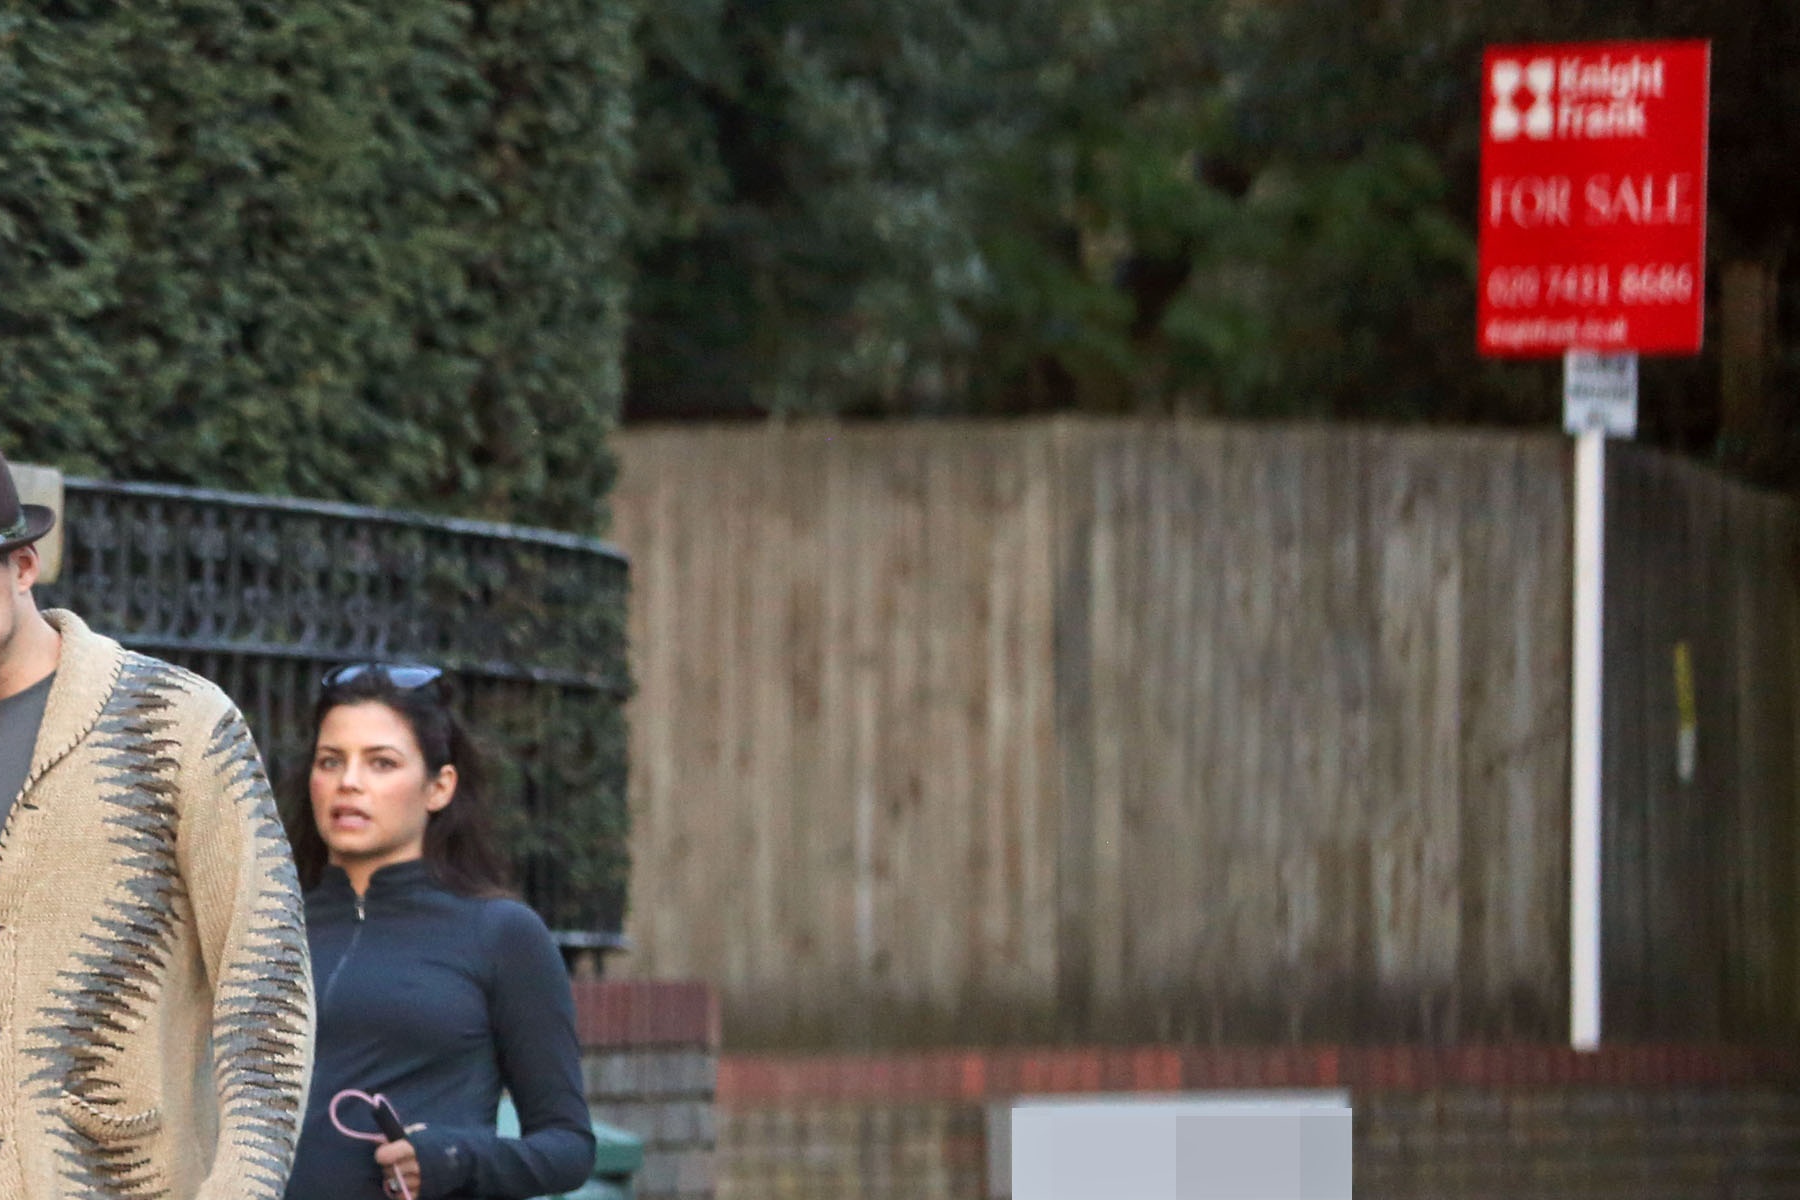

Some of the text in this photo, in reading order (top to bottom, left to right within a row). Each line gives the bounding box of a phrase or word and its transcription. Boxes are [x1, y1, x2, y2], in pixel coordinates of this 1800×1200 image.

[1559, 54, 1664, 99] Knight
[1558, 99, 1646, 138] Frank
[1490, 172, 1693, 228] FOR SALE
